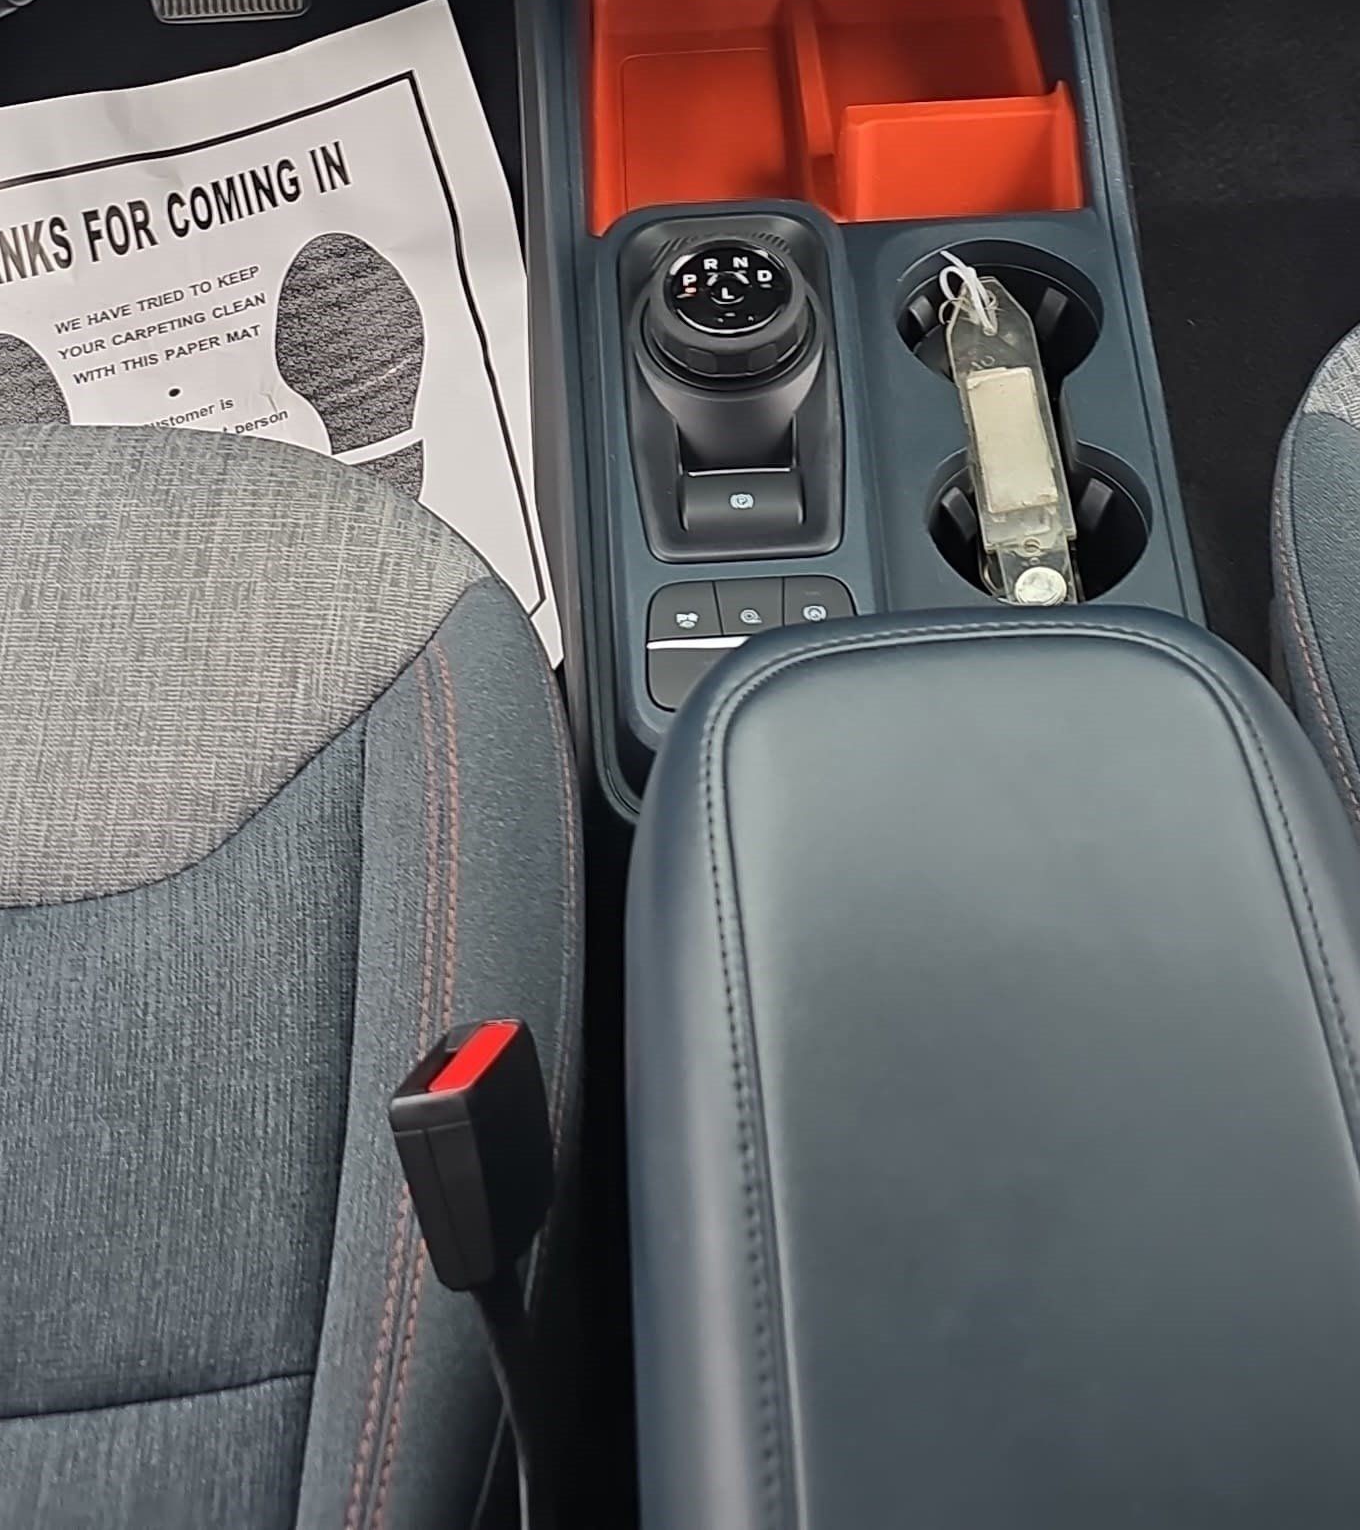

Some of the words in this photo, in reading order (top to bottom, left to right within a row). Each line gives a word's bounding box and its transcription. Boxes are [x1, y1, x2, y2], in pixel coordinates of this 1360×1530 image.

[83, 200, 159, 263] FOR
[167, 159, 300, 239] COMING
[309, 141, 352, 193] IN
[704, 258, 718, 270] R
[733, 256, 749, 268] N
[683, 274, 696, 286] P
[757, 270, 772, 282] D
[55, 317, 81, 334] WE
[87, 304, 132, 326] HAVE
[136, 289, 184, 312] TRIED
[189, 281, 212, 296] TO
[217, 266, 260, 289] KEEP
[722, 287, 734, 300] L
[58, 339, 106, 360] YOUR
[112, 312, 206, 346] CARPETING
[212, 293, 266, 319] CLEAN
[73, 364, 116, 385] WITH
[122, 353, 159, 372] THIS
[165, 336, 221, 361] PAPER
[226, 325, 261, 344] MAT
[220, 399, 234, 411] is
[235, 410, 289, 434] person
